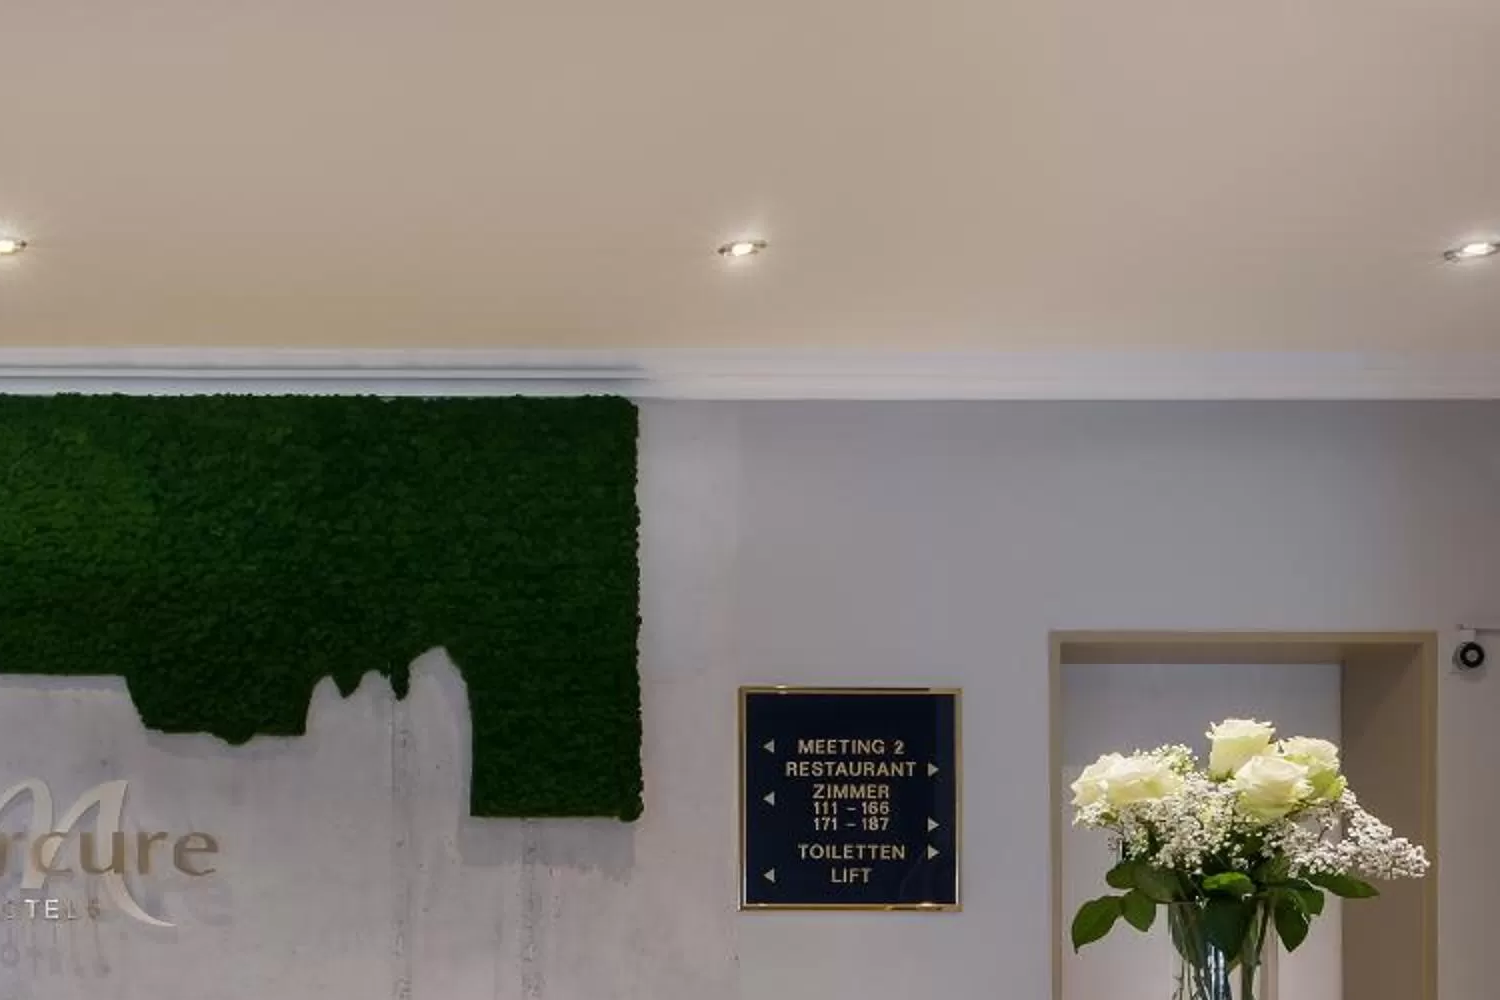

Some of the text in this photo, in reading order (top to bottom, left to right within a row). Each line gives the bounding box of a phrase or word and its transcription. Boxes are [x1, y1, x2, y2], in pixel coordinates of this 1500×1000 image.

[797, 739, 905, 755] MEETING 2
[785, 761, 917, 777] RESTAURANT
[812, 784, 890, 799] ZIMMER
[813, 801, 838, 815] 111
[813, 817, 838, 831] 171
[861, 817, 890, 831] 187
[797, 844, 906, 860] TOILETTEN
[830, 867, 873, 883] LIFT
